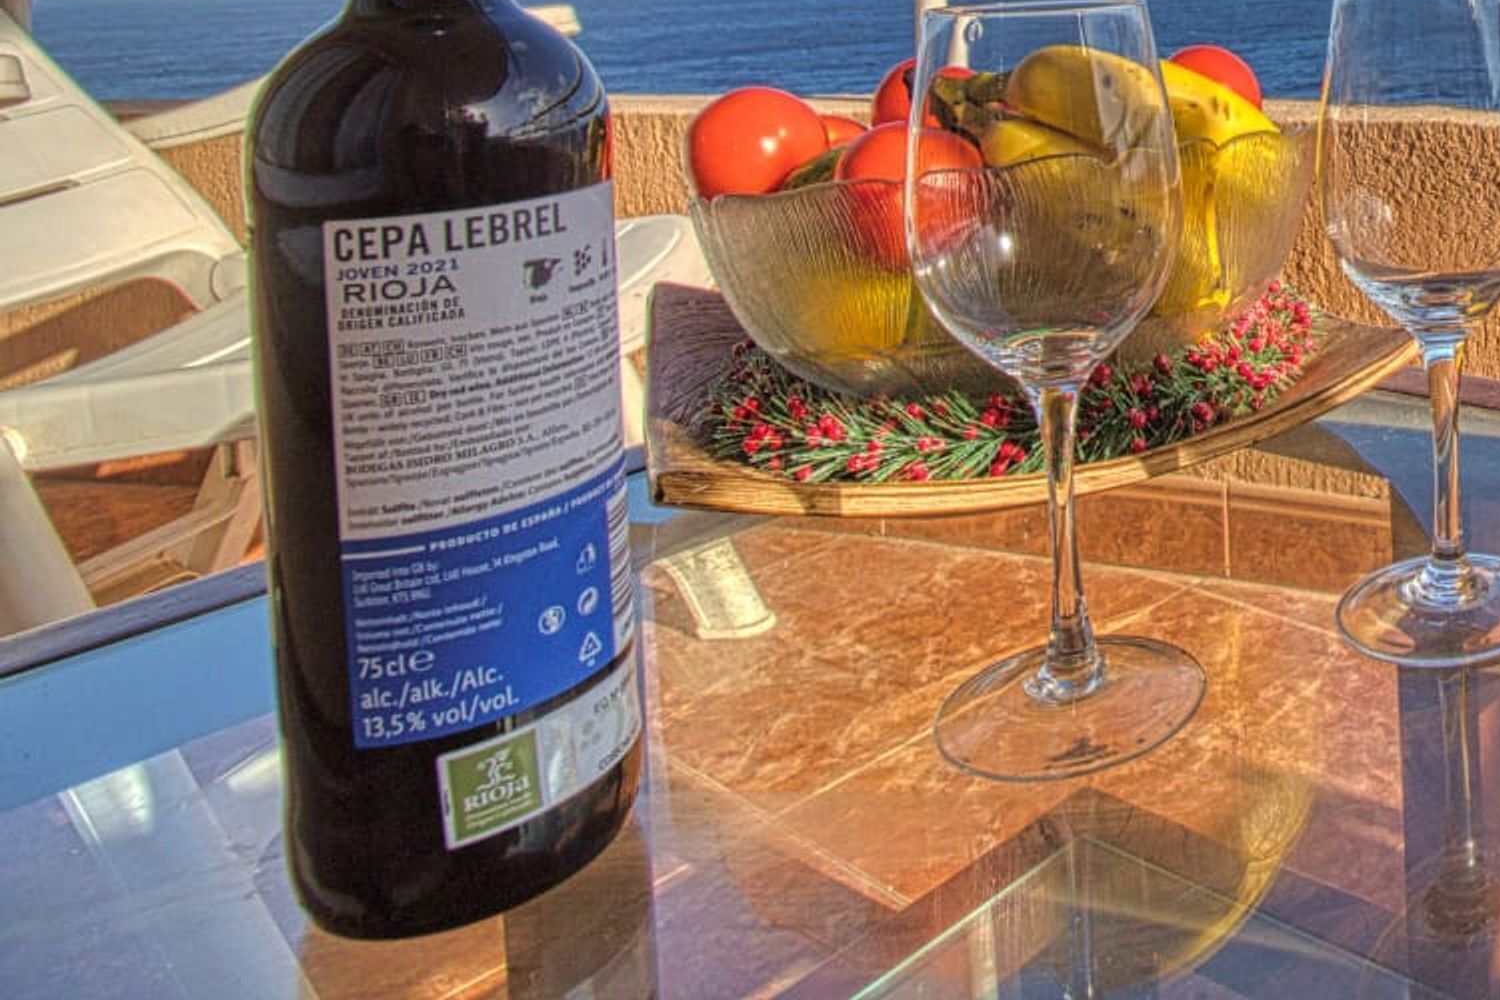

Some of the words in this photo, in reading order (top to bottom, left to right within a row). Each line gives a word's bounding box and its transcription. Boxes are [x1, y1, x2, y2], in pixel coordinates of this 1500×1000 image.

[335, 223, 430, 262] CEPA
[445, 202, 567, 252] LEBREL
[336, 264, 398, 281] JOVEN
[407, 258, 459, 275] 2021
[343, 275, 456, 304] RIOJA
[443, 296, 461, 310] DE
[337, 318, 384, 331] ORIGEN
[388, 308, 466, 327] CALIFICADA
[429, 529, 499, 550] PRODUCTO
[501, 523, 519, 534] DE
[432, 686, 520, 728] vol/vol.
